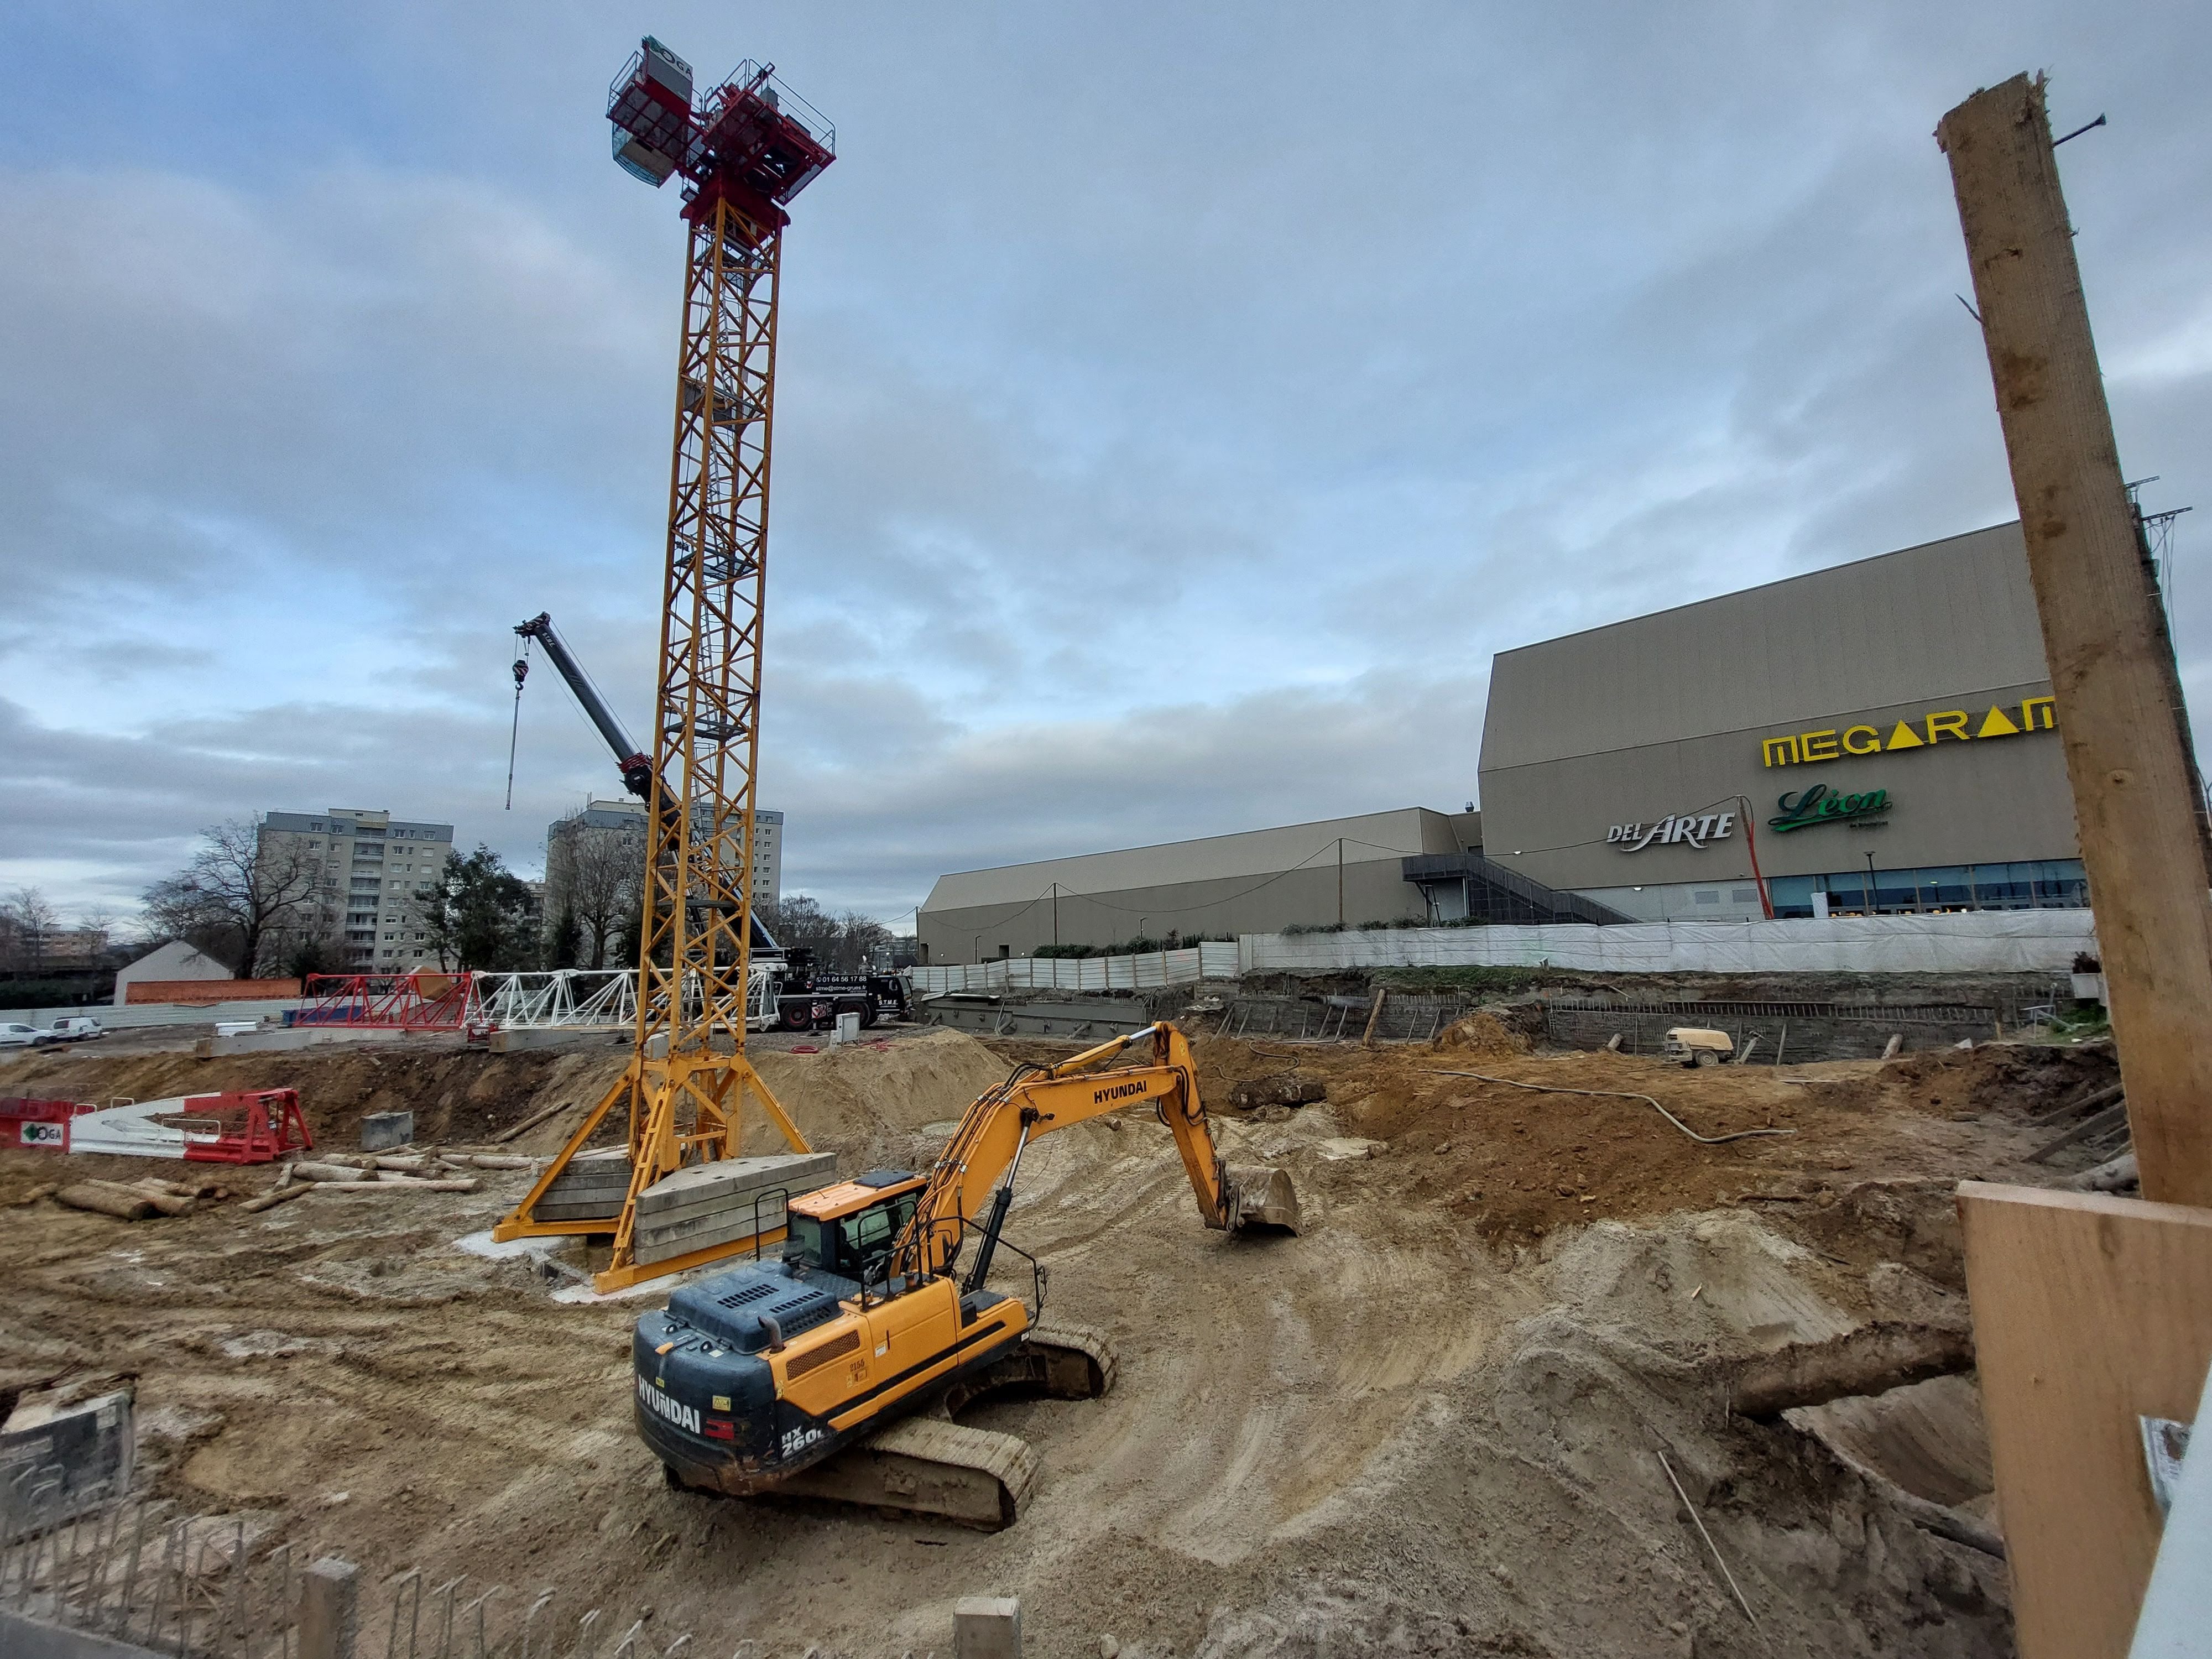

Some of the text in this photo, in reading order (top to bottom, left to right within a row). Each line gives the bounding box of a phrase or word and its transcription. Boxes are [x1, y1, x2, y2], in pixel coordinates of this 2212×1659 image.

[1768, 784, 1892, 830] Léon
[1606, 812, 1736, 852] DEL ARTE
[1094, 1080, 1147, 1104] HYUNDAI
[638, 1374, 701, 1434] HYUNDAI
[781, 1425, 801, 1445] HX
